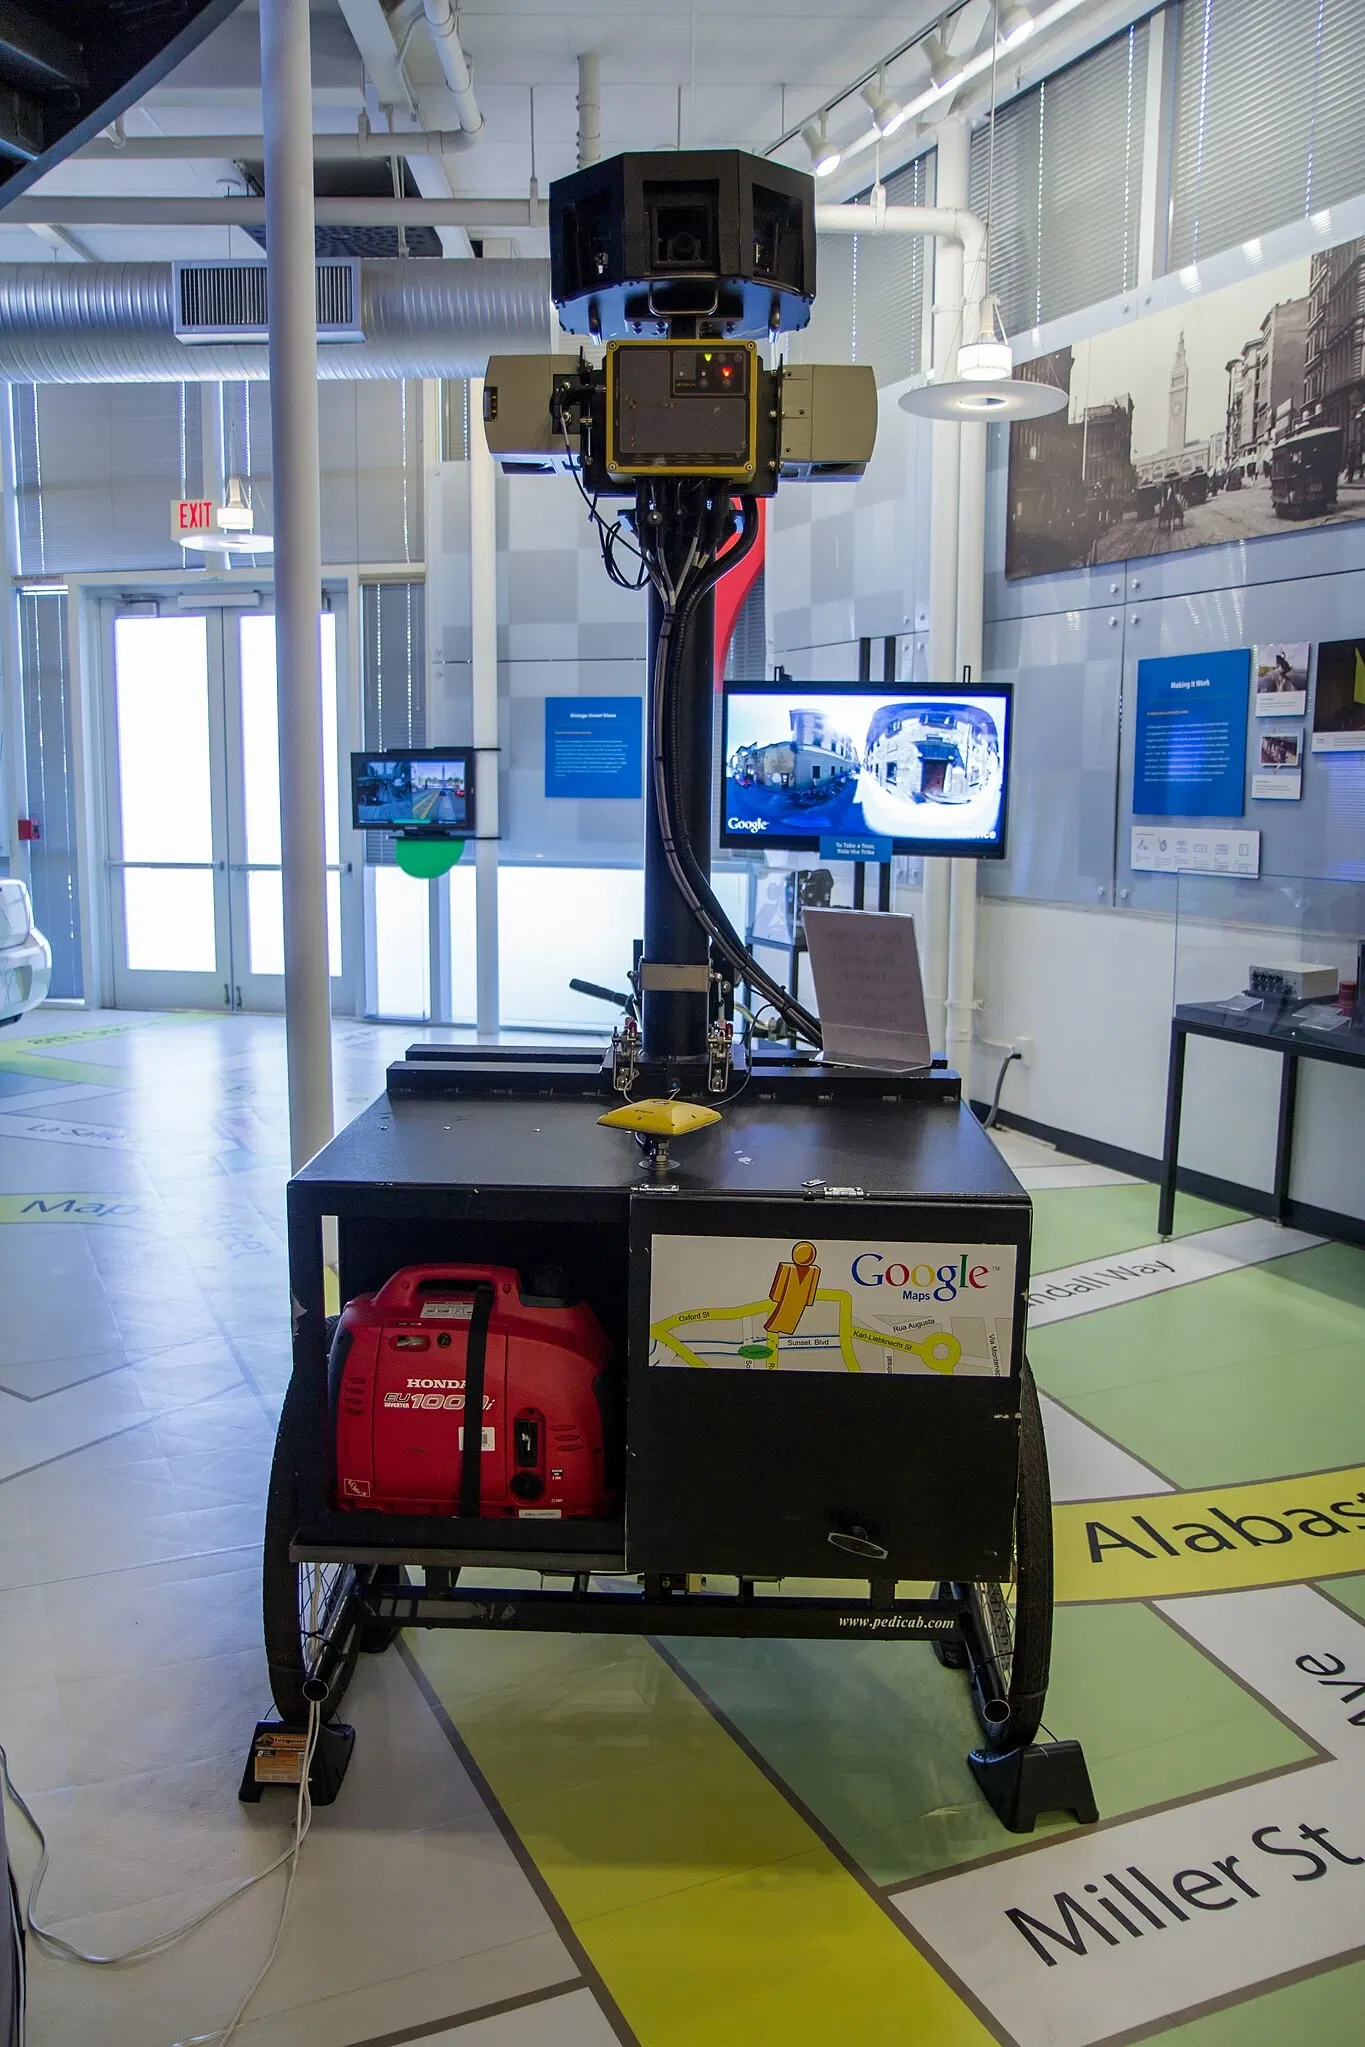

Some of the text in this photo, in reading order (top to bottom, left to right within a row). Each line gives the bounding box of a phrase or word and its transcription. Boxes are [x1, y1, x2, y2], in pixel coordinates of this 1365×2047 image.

[179, 502, 212, 528] EXIT
[1170, 682, 1190, 690] Making
[727, 816, 769, 834] Google
[851, 1252, 989, 1302] Google
[1028, 1260, 1176, 1308] ndall Way
[902, 1290, 931, 1302] Maps
[678, 1311, 711, 1322] Oxford St
[893, 1318, 936, 1333] Rua Augusta
[988, 1333, 996, 1345] Via
[904, 1343, 912, 1351] St
[838, 1615, 956, 1630] www.pedicab.com
[1003, 1822, 1365, 1968] Miller St
